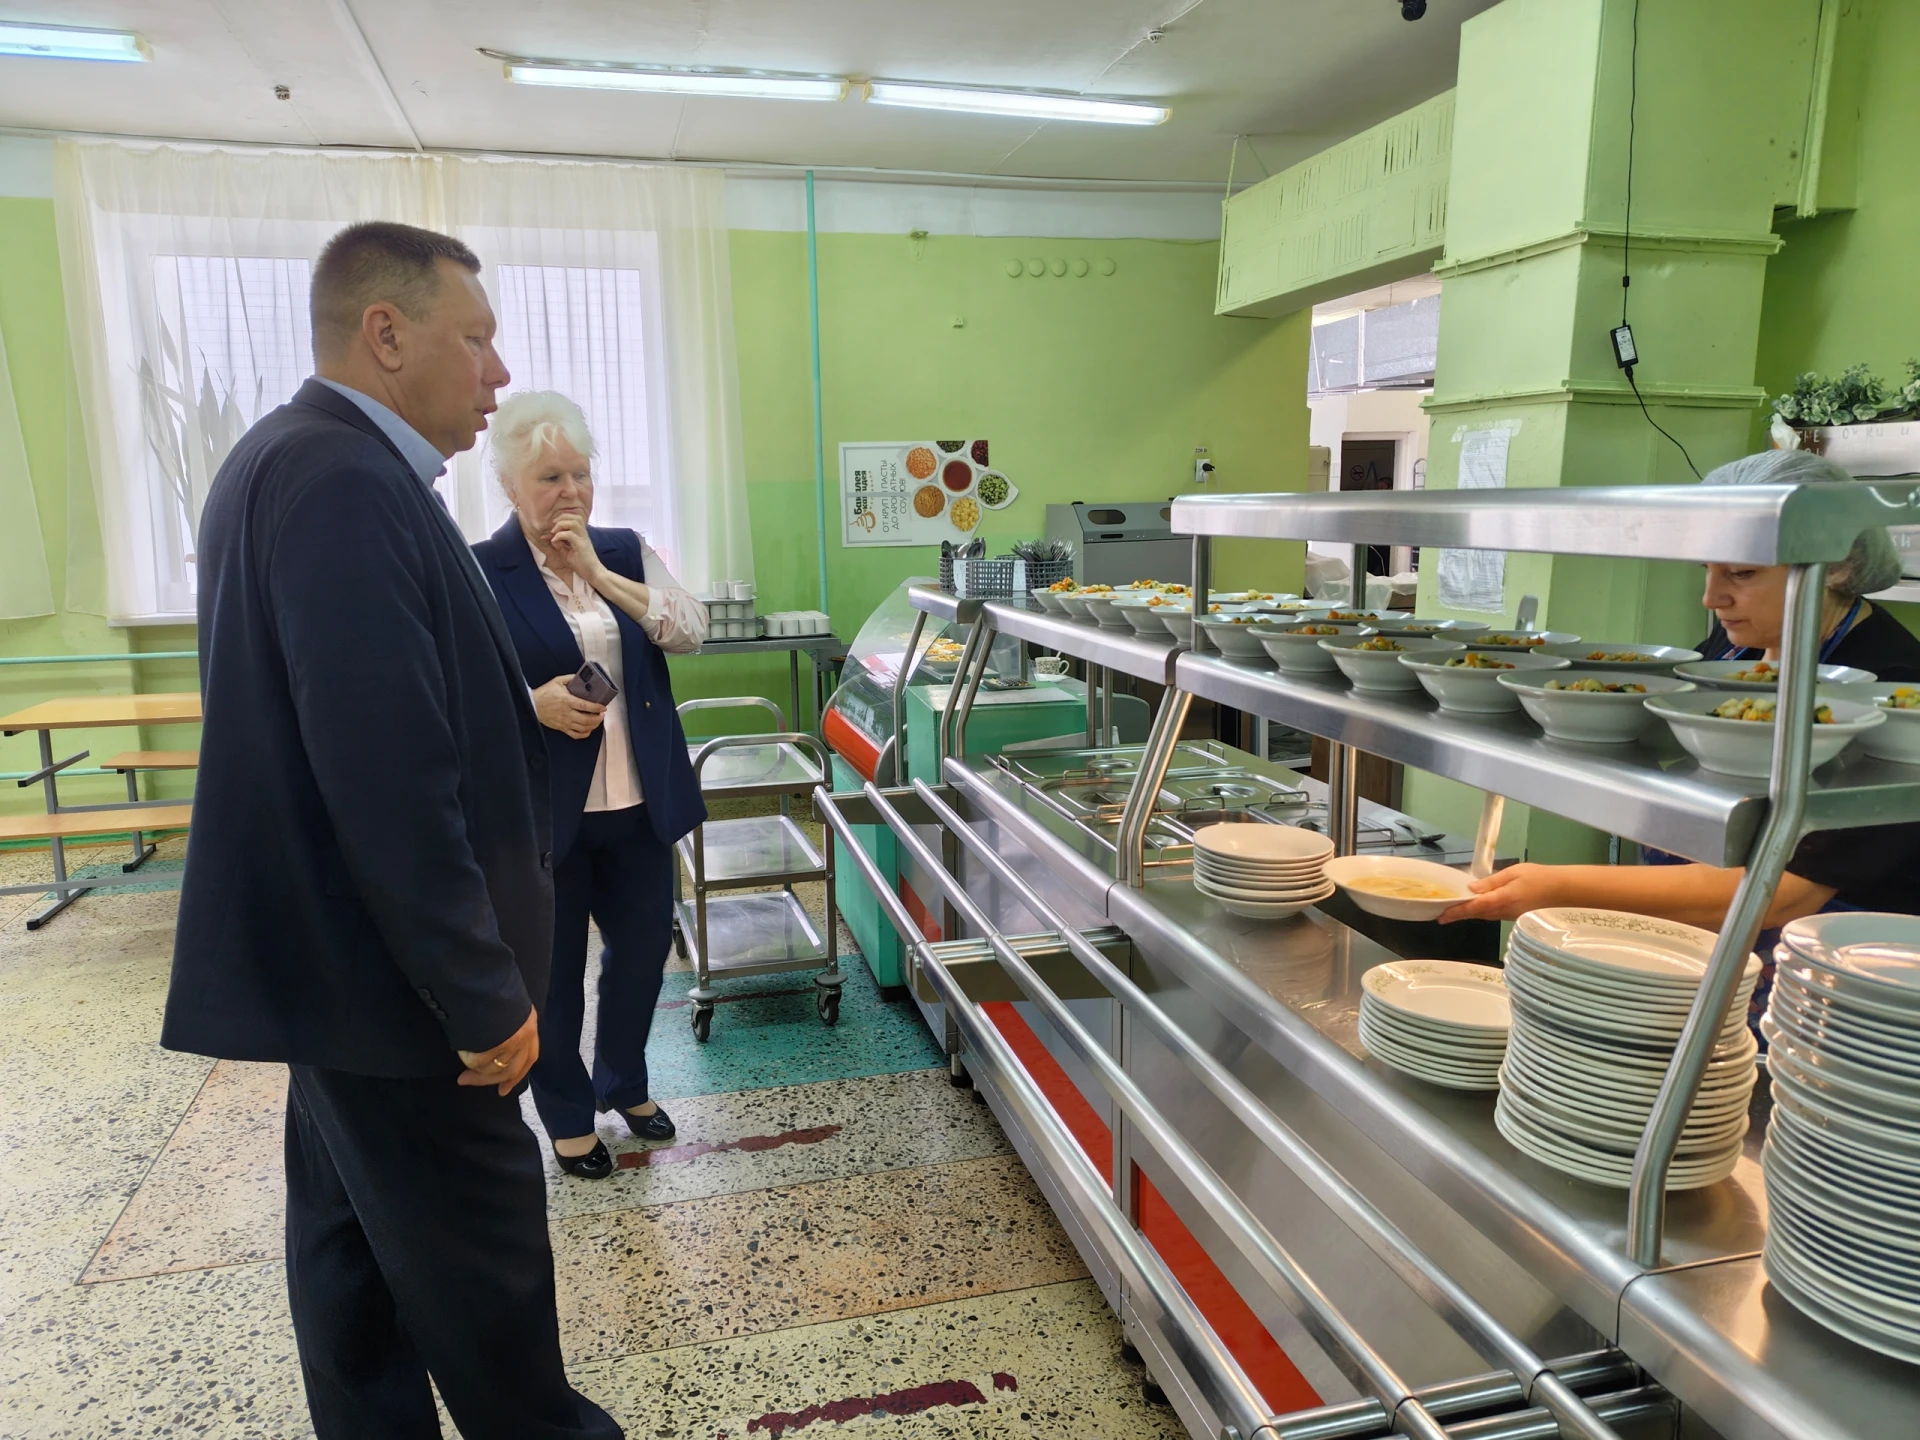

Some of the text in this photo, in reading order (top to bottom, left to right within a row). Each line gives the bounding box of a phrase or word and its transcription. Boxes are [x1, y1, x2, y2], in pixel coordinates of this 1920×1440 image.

[880, 460, 888, 488] ПАСТЫ
[881, 499, 890, 519] КРУП
[889, 462, 899, 530] ДО АРОАТНЫХ
[899, 477, 907, 514] СОУОВ!
[882, 521, 890, 533] ОТ
